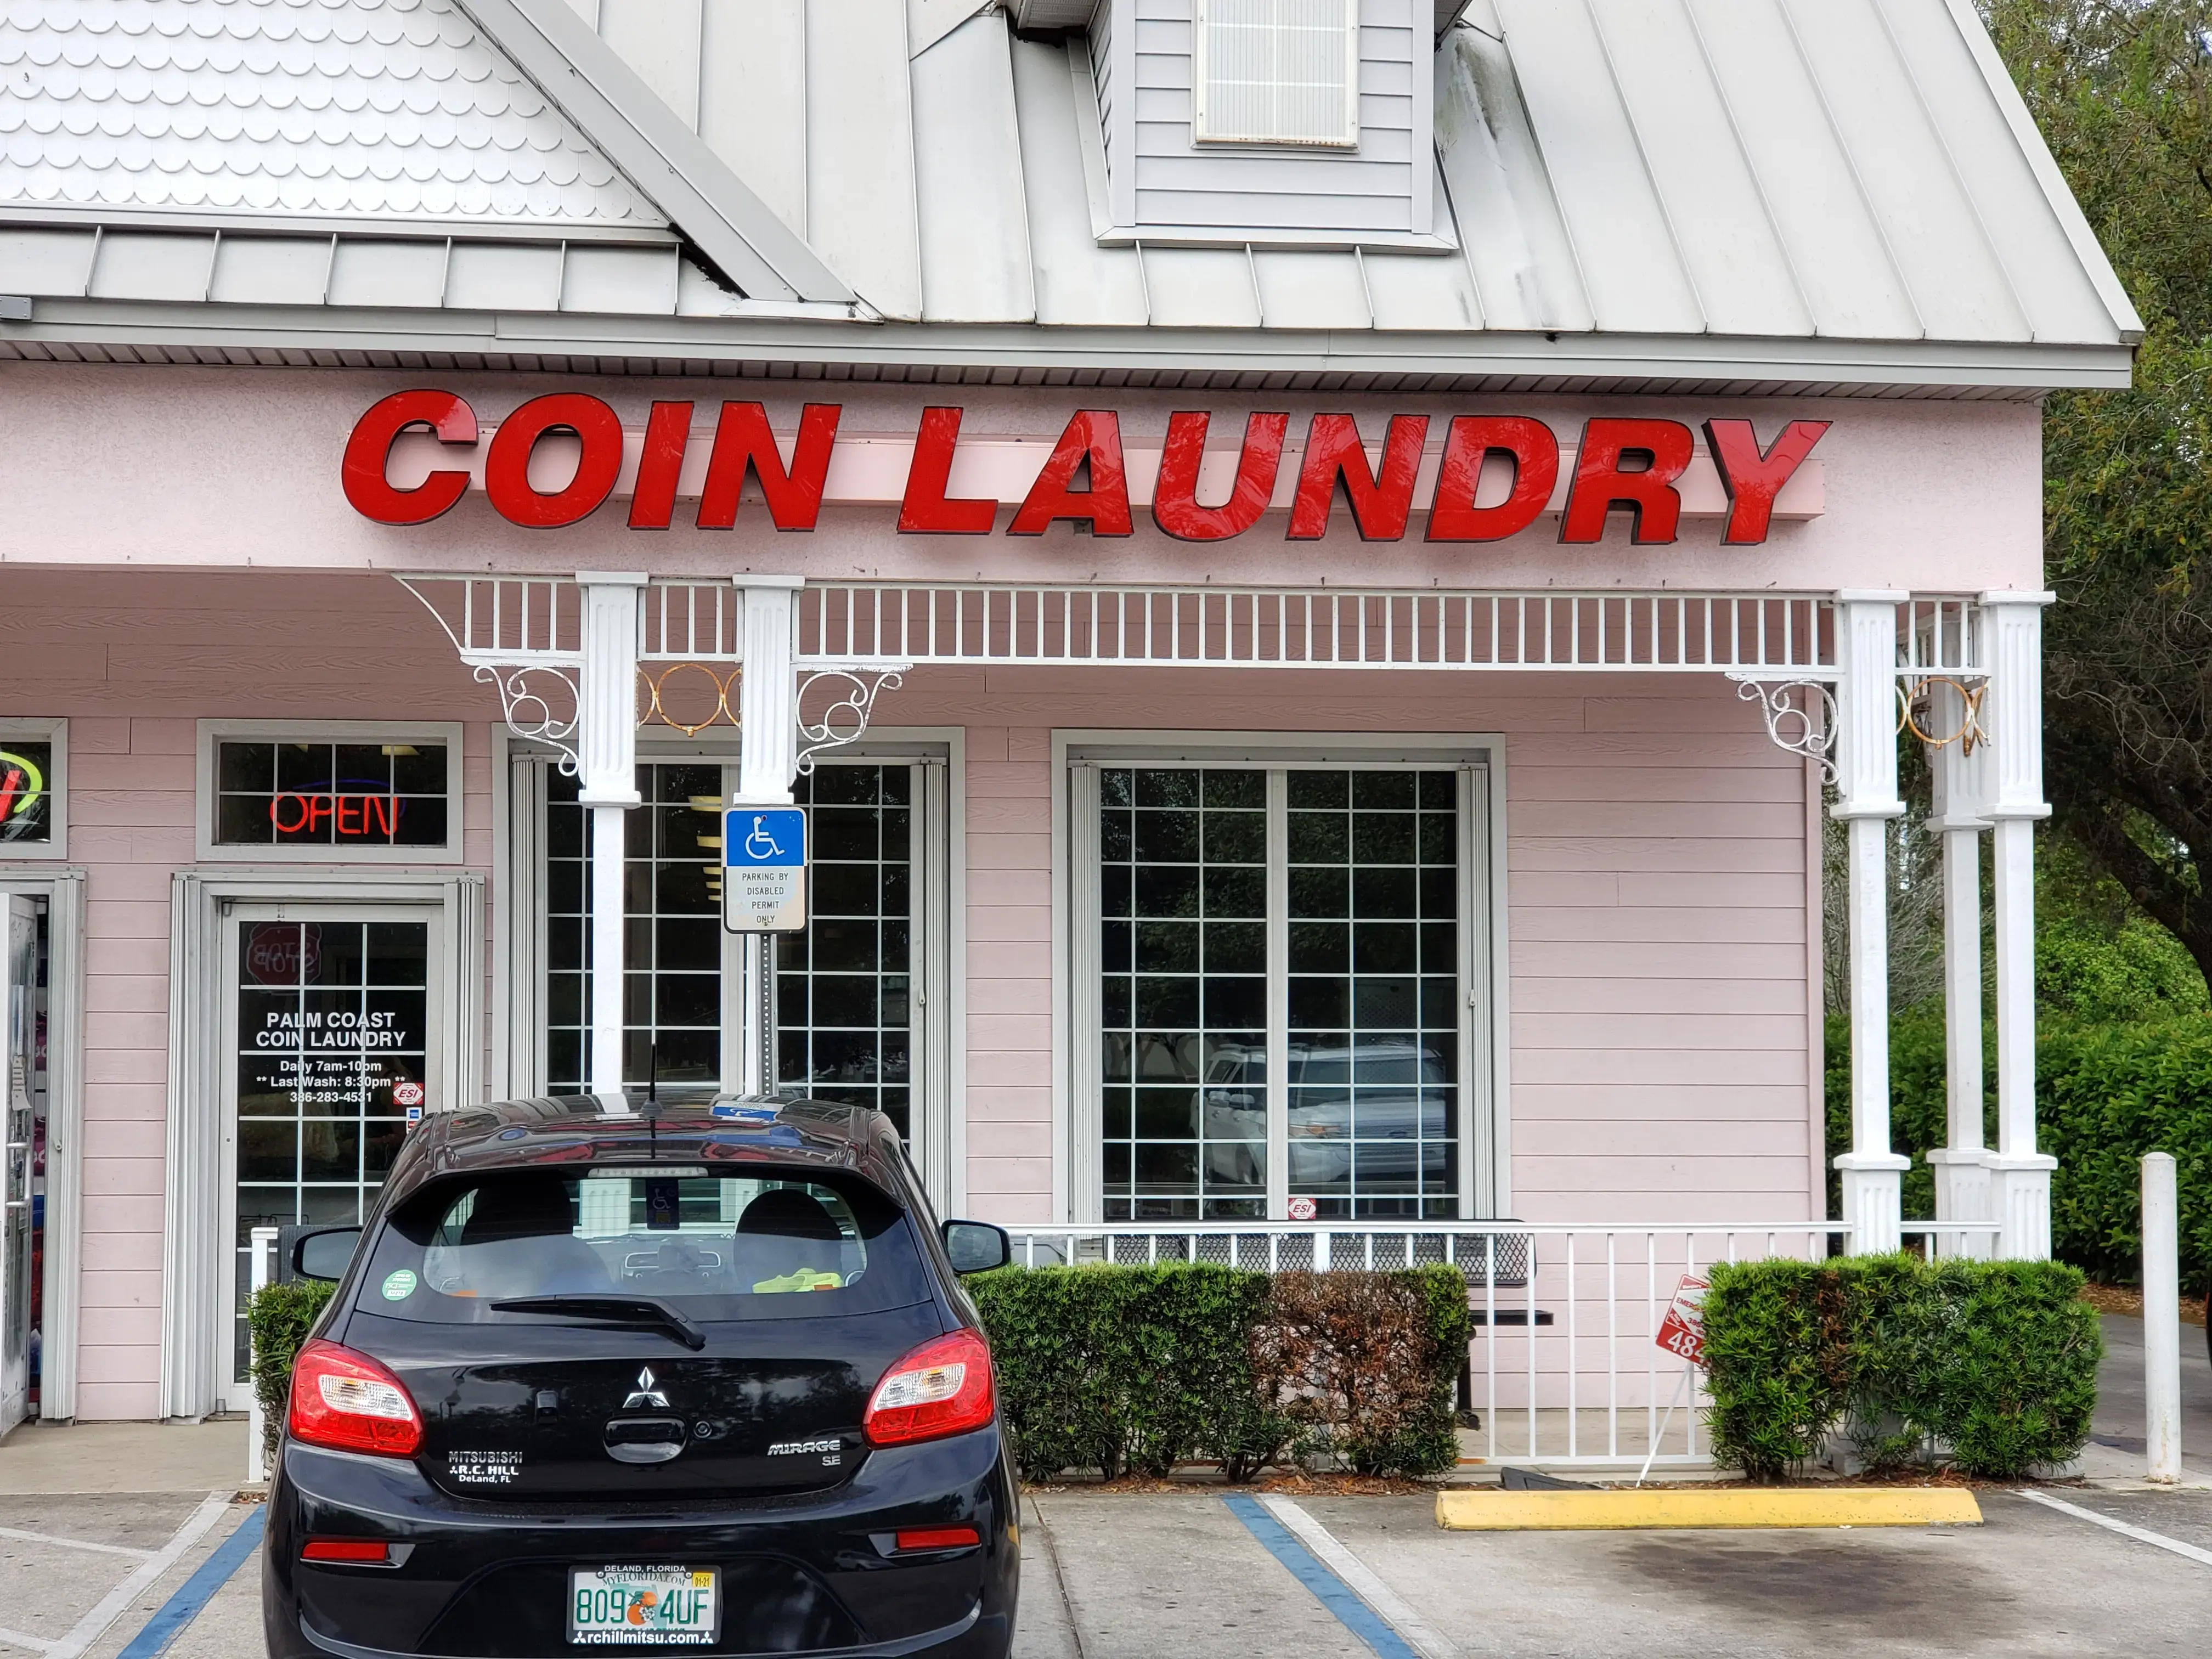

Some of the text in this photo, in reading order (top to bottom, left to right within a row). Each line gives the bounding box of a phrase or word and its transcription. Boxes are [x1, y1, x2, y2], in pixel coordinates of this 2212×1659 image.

[341, 389, 1833, 547] COIN LAUNDRY
[270, 791, 398, 836] OPEN
[757, 915, 775, 923] ONLY
[267, 1013, 396, 1028] PALM COAST
[256, 1031, 406, 1047] COIN LAUNDRY
[280, 1061, 382, 1074] Daily 7am-10pm
[271, 1077, 298, 1087] Last
[302, 1076, 341, 1087] Wash:
[345, 1076, 391, 1089] 8:30pm
[290, 1092, 371, 1102] 386-283-4531
[398, 1089, 419, 1098] ESI
[1293, 1204, 1311, 1212] ESI
[767, 1440, 840, 1455] MIRAGE
[449, 1451, 522, 1463] MITSUBISHI
[822, 1455, 840, 1466] SE
[459, 1465, 519, 1475] R.C. HILL
[459, 1475, 498, 1483] DeLand,
[603, 1572, 686, 1586] MYFLORIDA.COM
[577, 1589, 709, 1624] 809 4UF
[588, 1632, 699, 1644] rchillmitsu.com
